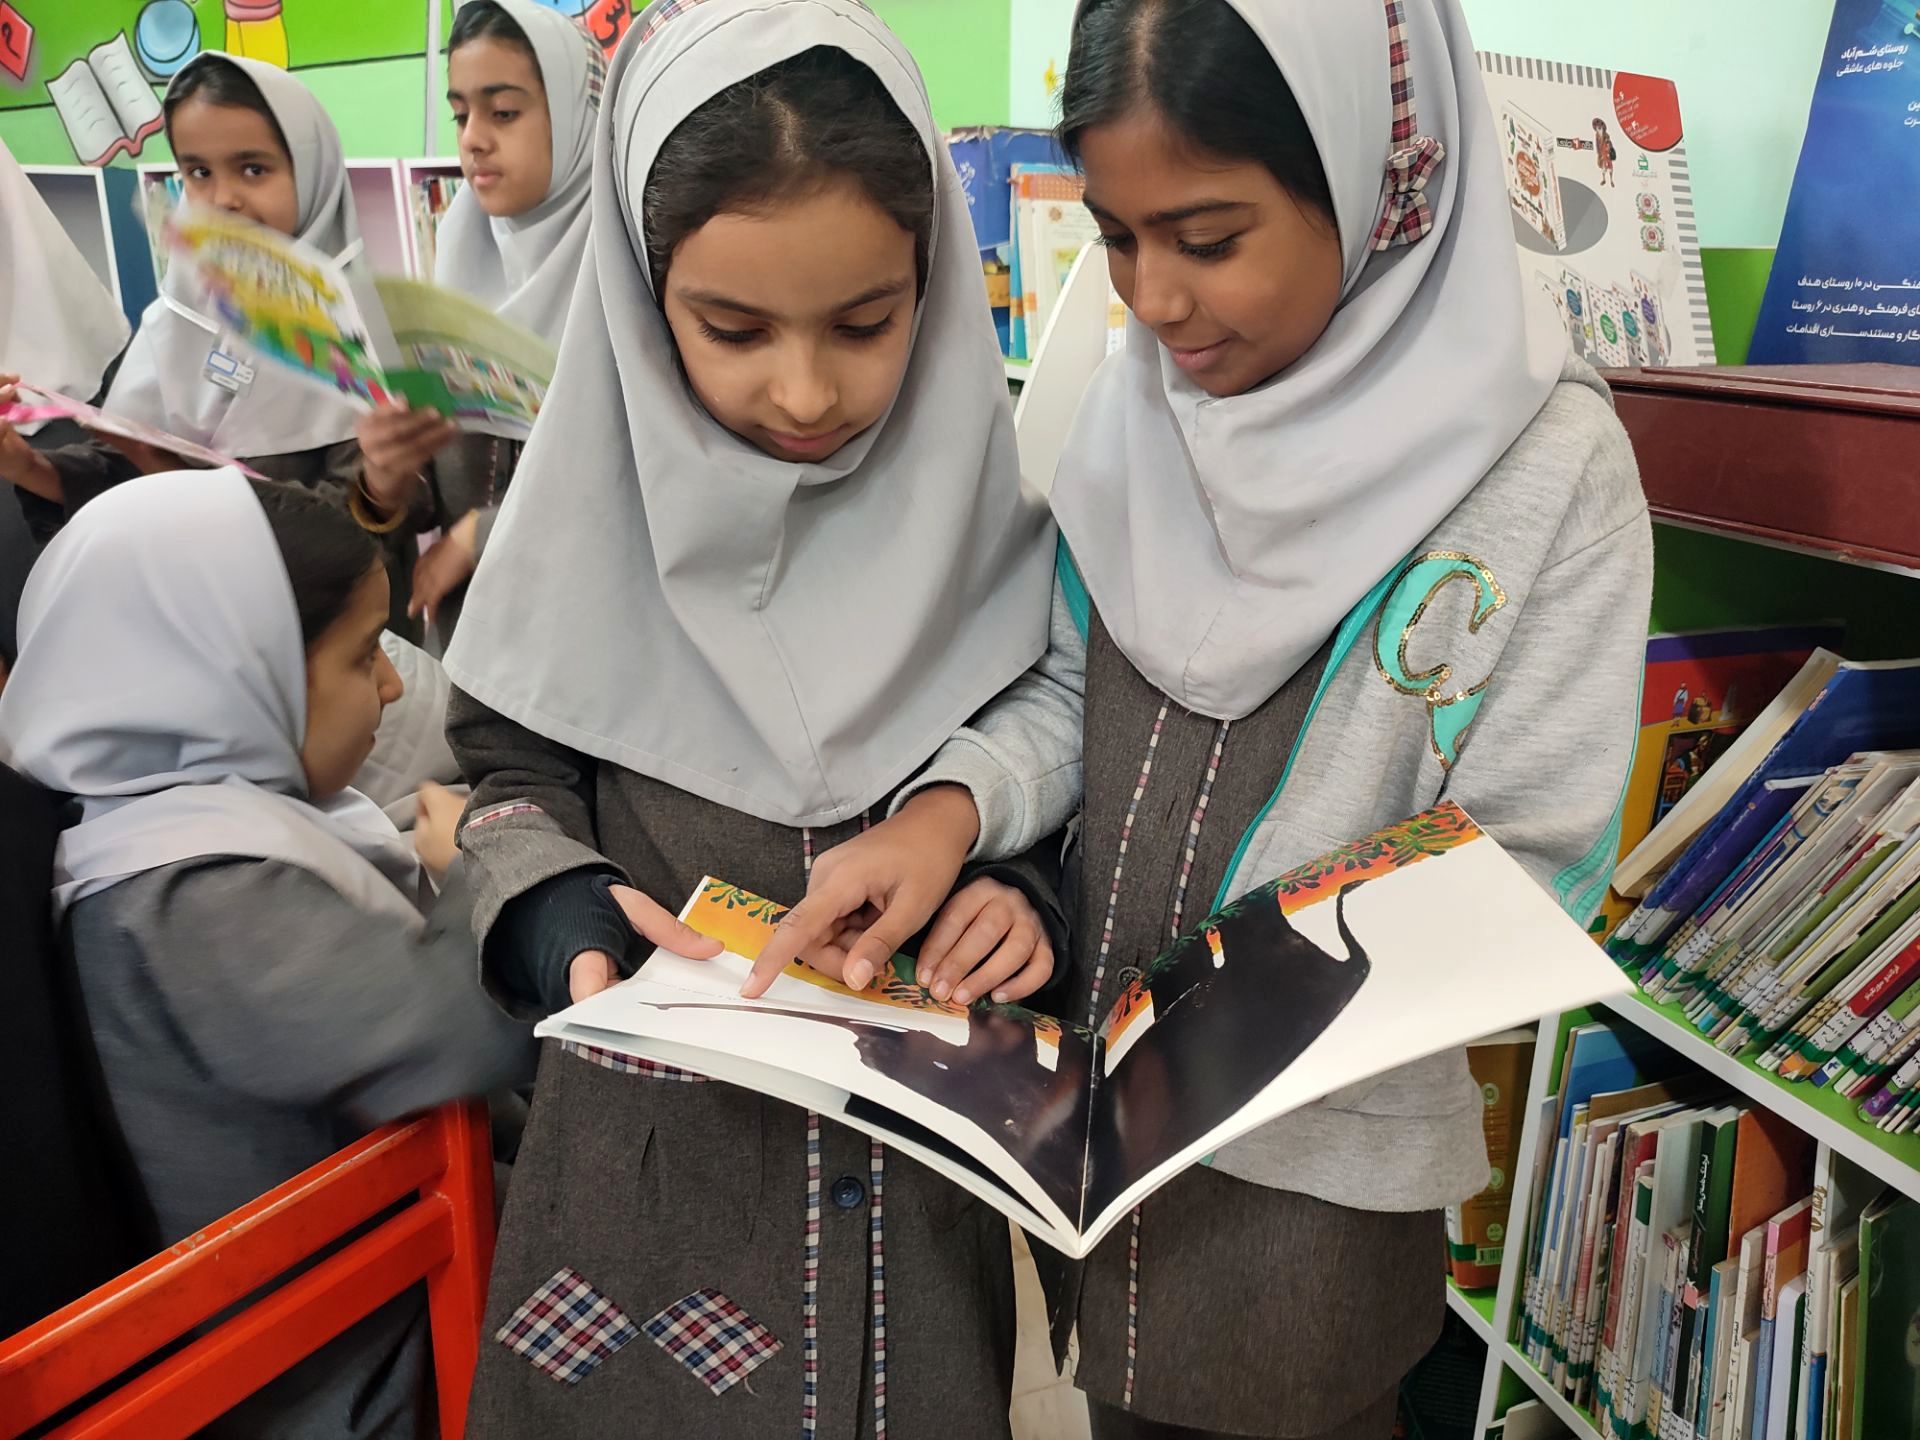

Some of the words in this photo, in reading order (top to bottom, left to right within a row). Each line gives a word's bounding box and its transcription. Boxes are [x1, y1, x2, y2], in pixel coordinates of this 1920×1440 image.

[1876, 43, 1909, 57] روستای
[1836, 63, 1864, 77] عاشقی
[1864, 61, 1882, 74] های
[1883, 58, 1904, 71] جلوه
[1797, 275, 1821, 287] هدف
[1822, 277, 1854, 290] روستای
[1862, 279, 1873, 291] در
[1791, 299, 1815, 312] روستا
[1821, 304, 1832, 314] در
[1832, 303, 1857, 314] هنری
[1859, 306, 1864, 316] و
[1865, 302, 1908, 317] فرهنگی
[1786, 323, 1820, 335] اقدامات
[1896, 333, 1902, 342] و
